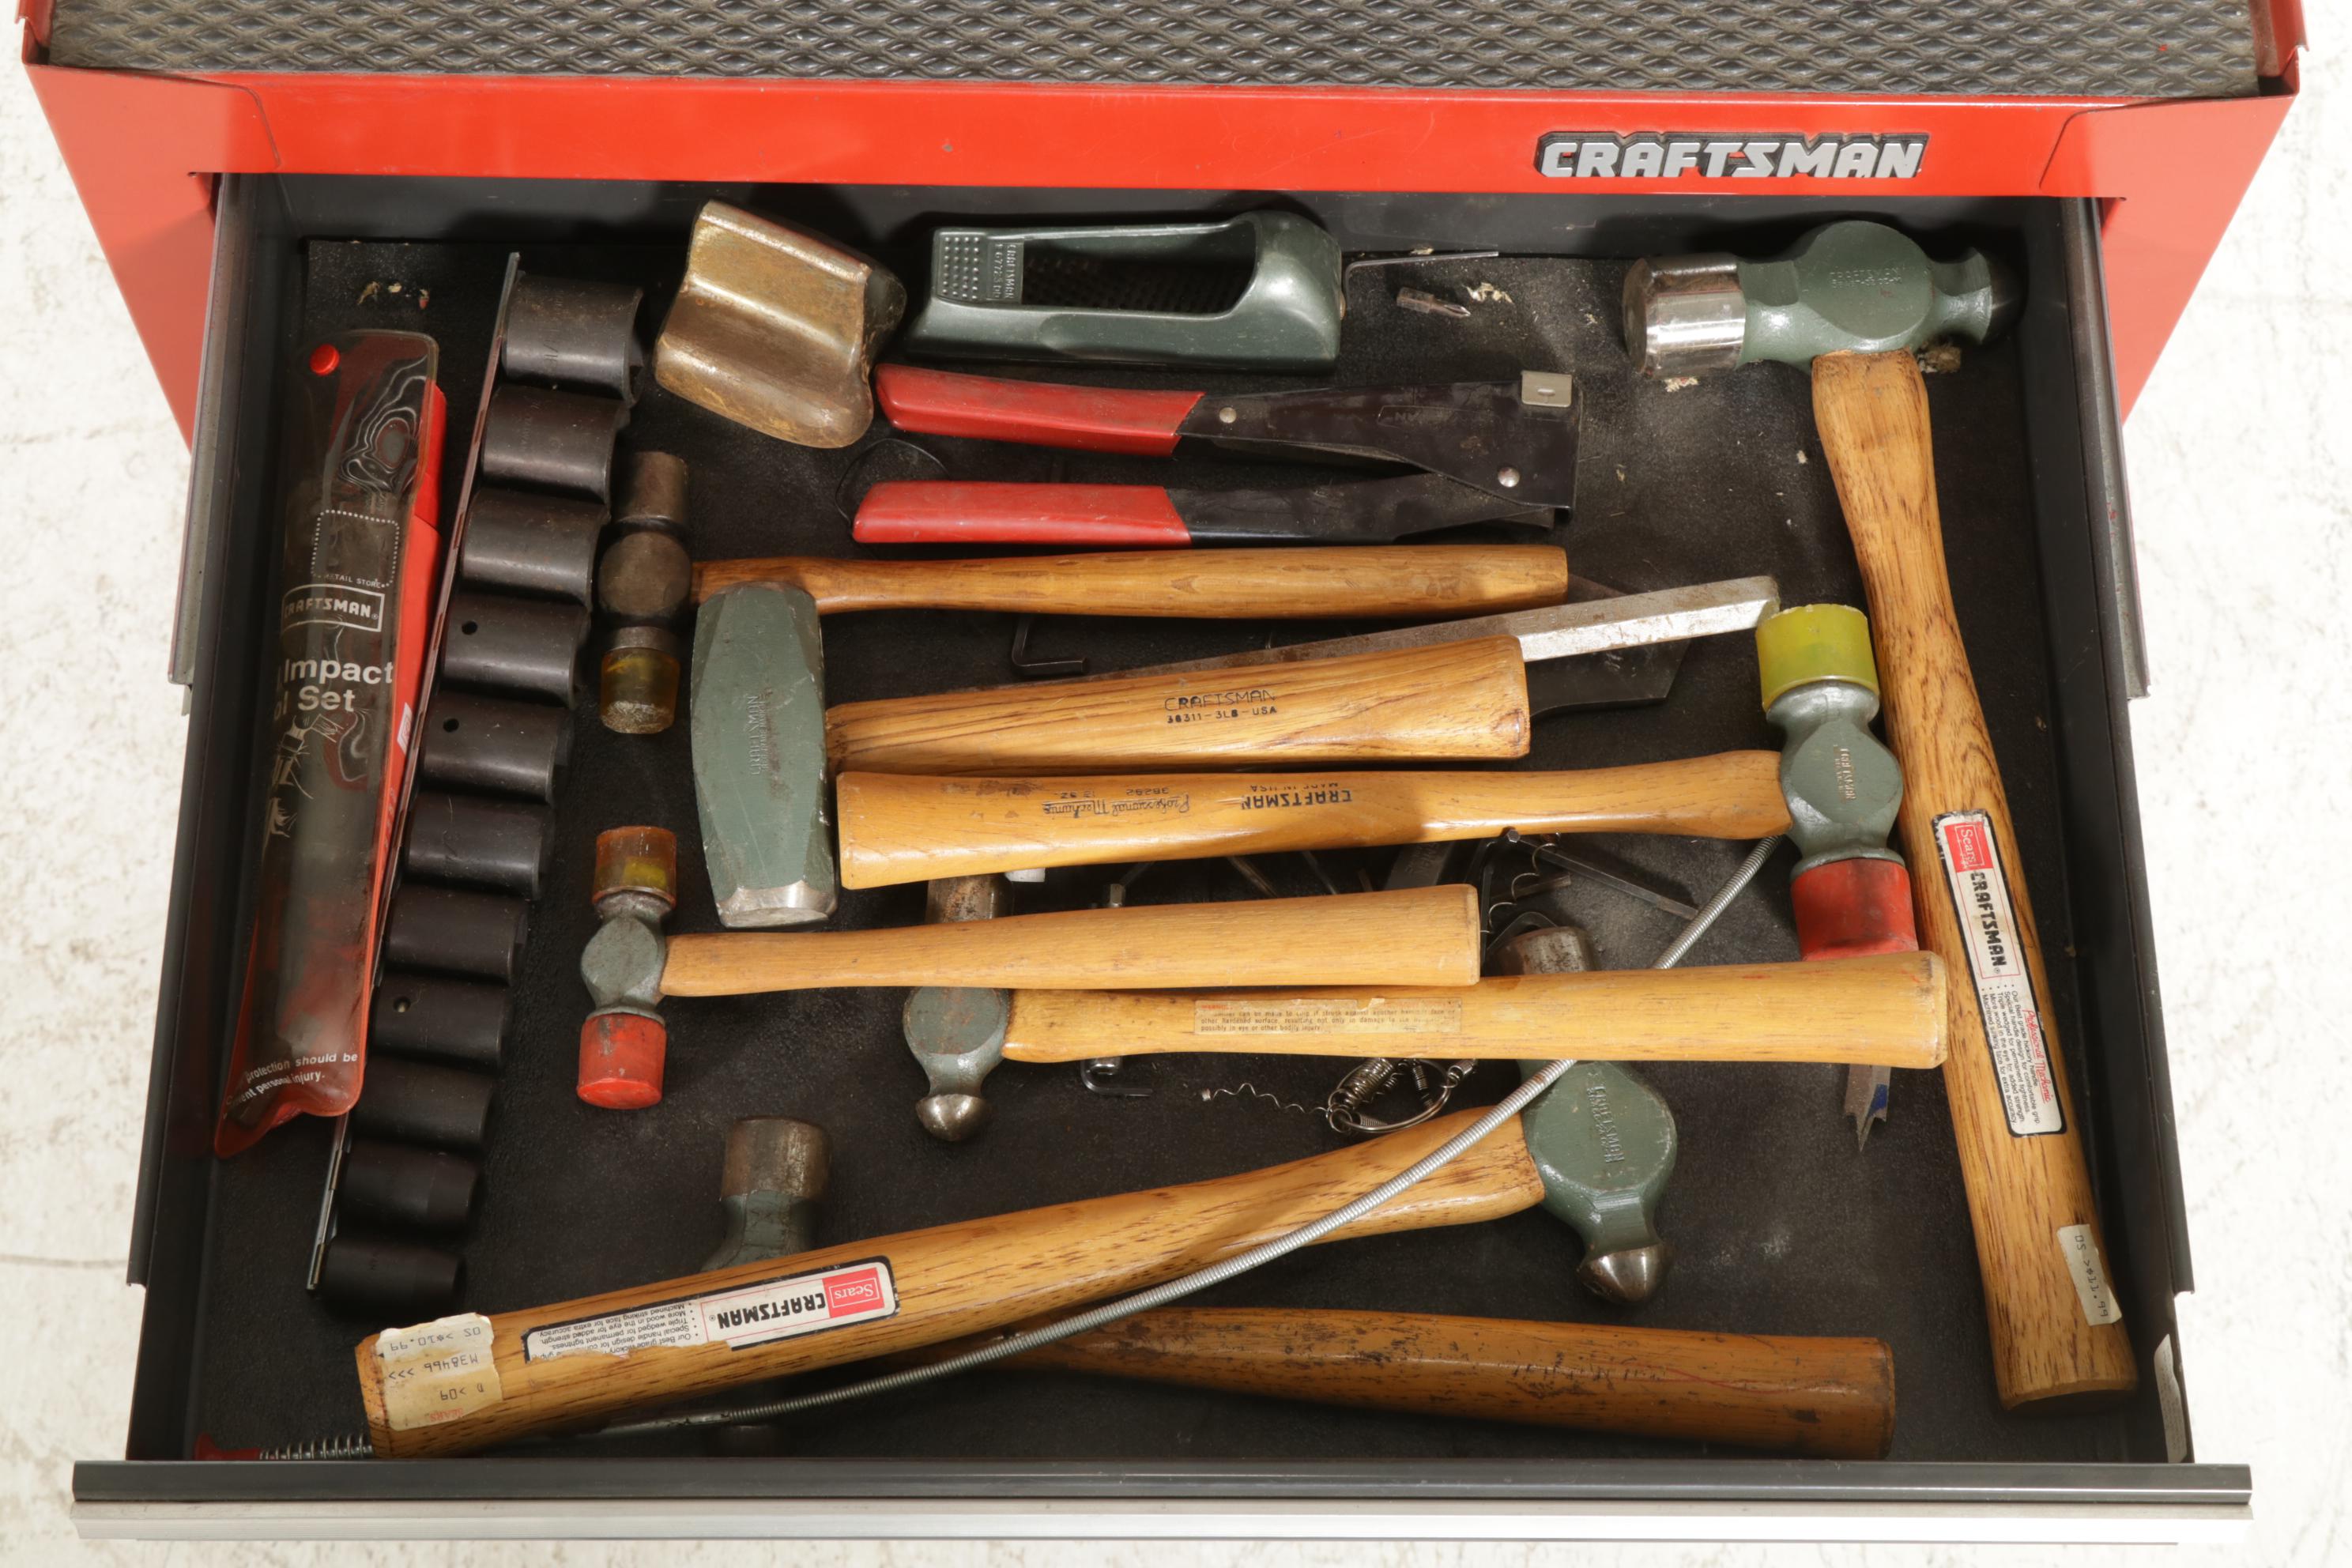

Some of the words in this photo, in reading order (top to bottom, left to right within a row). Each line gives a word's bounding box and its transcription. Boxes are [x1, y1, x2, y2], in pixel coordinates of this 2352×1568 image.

[1539, 141, 1924, 178] CRAFTSMAN
[285, 597, 371, 619] CRAFTSMAN
[284, 658, 394, 684] Impact
[297, 684, 356, 713] Set
[1164, 689, 1277, 712] CRAFTSMAN
[1110, 793, 1189, 817] Professional
[1240, 789, 1351, 810] CRAFTSMAN
[1042, 798, 1110, 821] Mechanic
[1959, 827, 1981, 864] Sears
[1988, 992, 1999, 1010] More
[1996, 992, 2007, 1010] Triple
[2003, 989, 2015, 1014] Special
[2011, 989, 2020, 1003] Our
[1993, 1011, 2003, 1029] wood
[2014, 1003, 2024, 1019] Best
[2000, 1010, 2013, 1037] wedged
[2009, 1015, 2021, 1037] handle
[2017, 1020, 2027, 1038] grade
[1981, 993, 1995, 1025] Machined
[1995, 1050, 2003, 1065] face
[2000, 1076, 2010, 1093] extra
[2000, 1037, 2008, 1049] the
[2014, 1038, 2026, 1061] design
[2022, 1039, 2034, 1063] hickory
[295, 1053, 337, 1067] should
[343, 1053, 358, 1062] be
[2001, 1050, 2011, 1062] eye
[2022, 1007, 2046, 1060] Professional
[2034, 1060, 2056, 1103] Mechanic
[2009, 1047, 2024, 1083] permanent
[292, 1070, 326, 1085] injury.
[2008, 1073, 2018, 1094] added
[2022, 1071, 2037, 1110] comfortable
[833, 1283, 874, 1302] Sears
[622, 1310, 648, 1321] striking
[646, 1314, 665, 1322] wood
[650, 1303, 684, 1315] Machined
[667, 1310, 685, 1318] More
[715, 1292, 827, 1329] CRAFTSMAN
[637, 1321, 665, 1332] wedged
[662, 1324, 689, 1335] Special
[667, 1317, 688, 1326] Triple
[537, 1325, 571, 1337] accuracy.
[572, 1329, 594, 1338] added
[585, 1329, 624, 1343] permanent
[611, 1335, 635, 1345] design
[637, 1330, 662, 1340] handle
[677, 1332, 691, 1341] Our
[658, 1336, 676, 1345] Best
